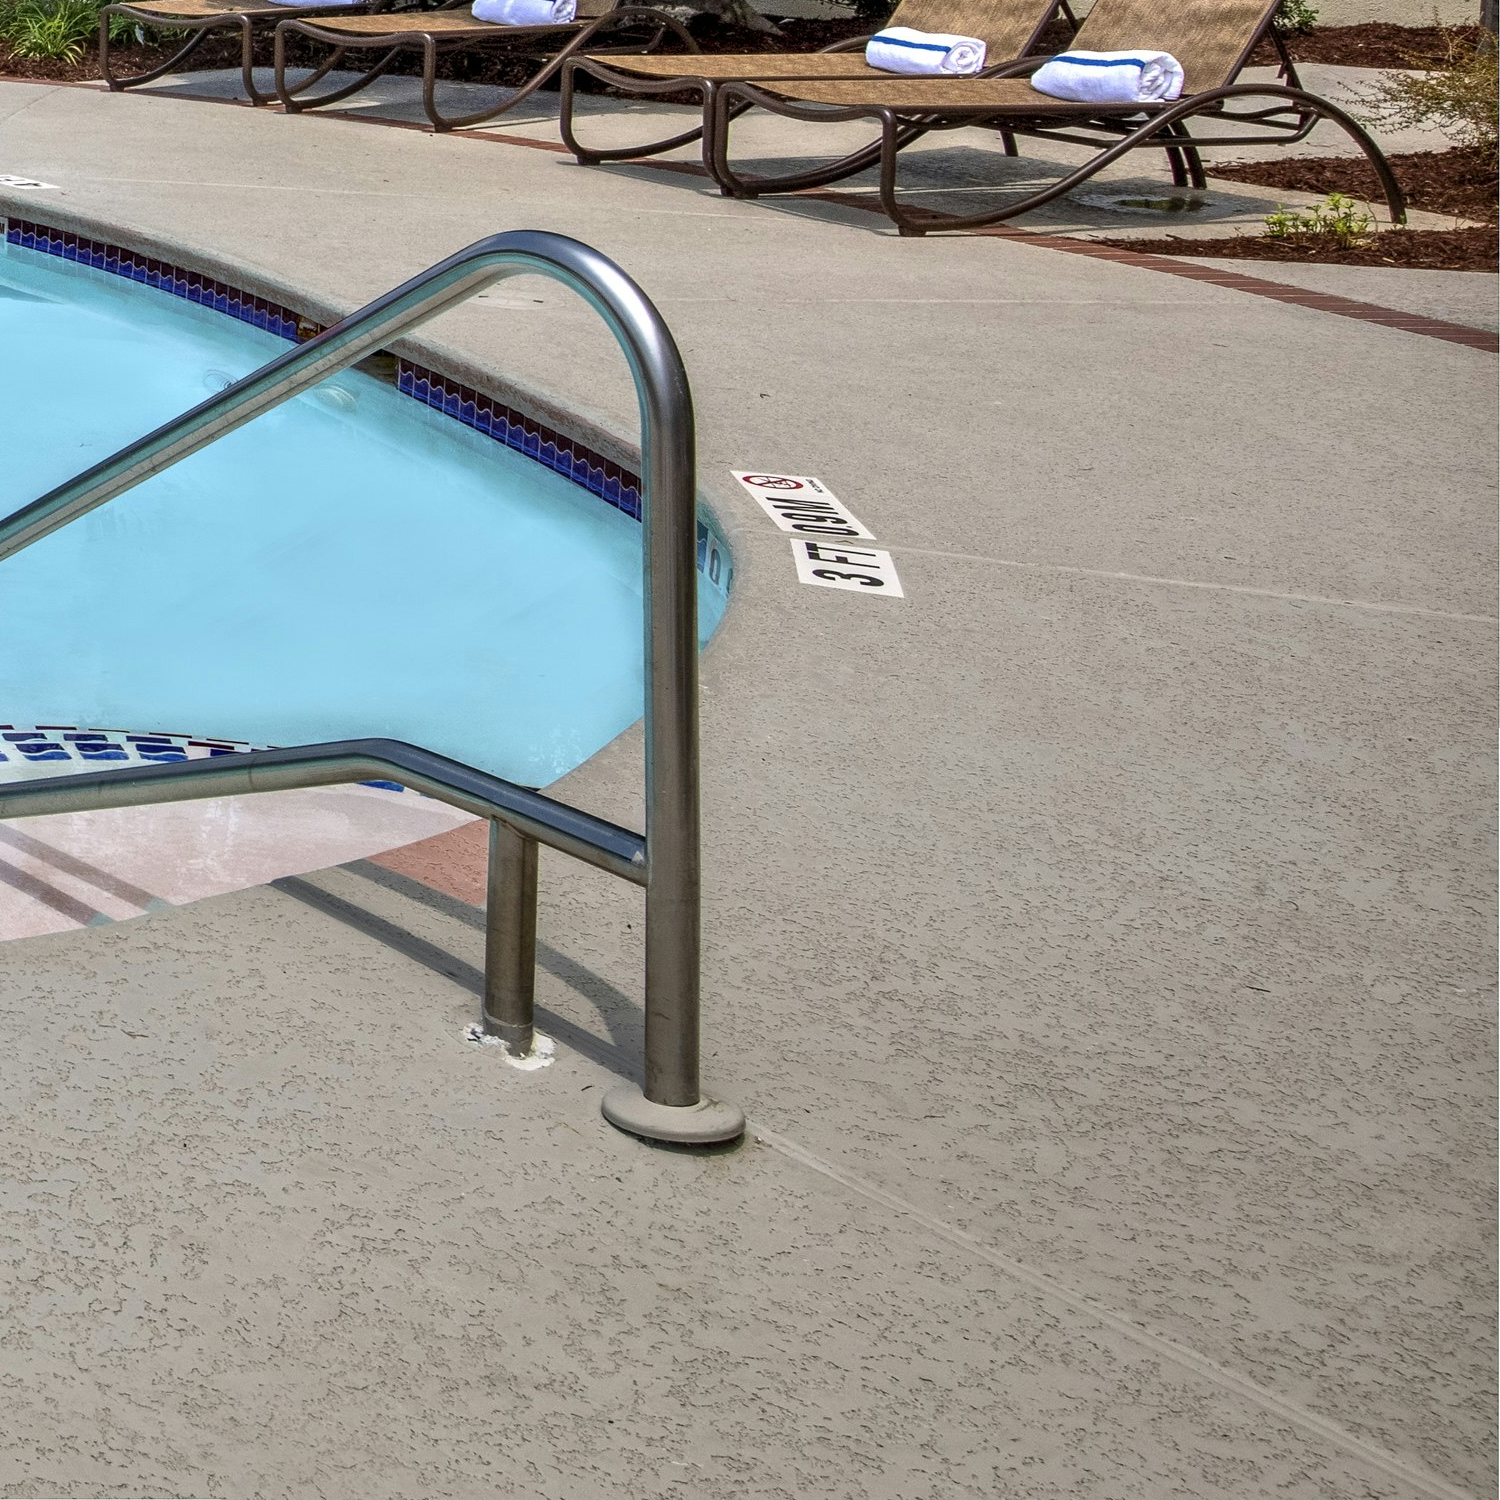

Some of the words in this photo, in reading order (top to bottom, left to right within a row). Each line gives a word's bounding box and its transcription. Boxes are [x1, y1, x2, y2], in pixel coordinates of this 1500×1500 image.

[765, 497, 860, 537] 0.9M
[805, 541, 881, 569] FT
[812, 569, 885, 587] 3
